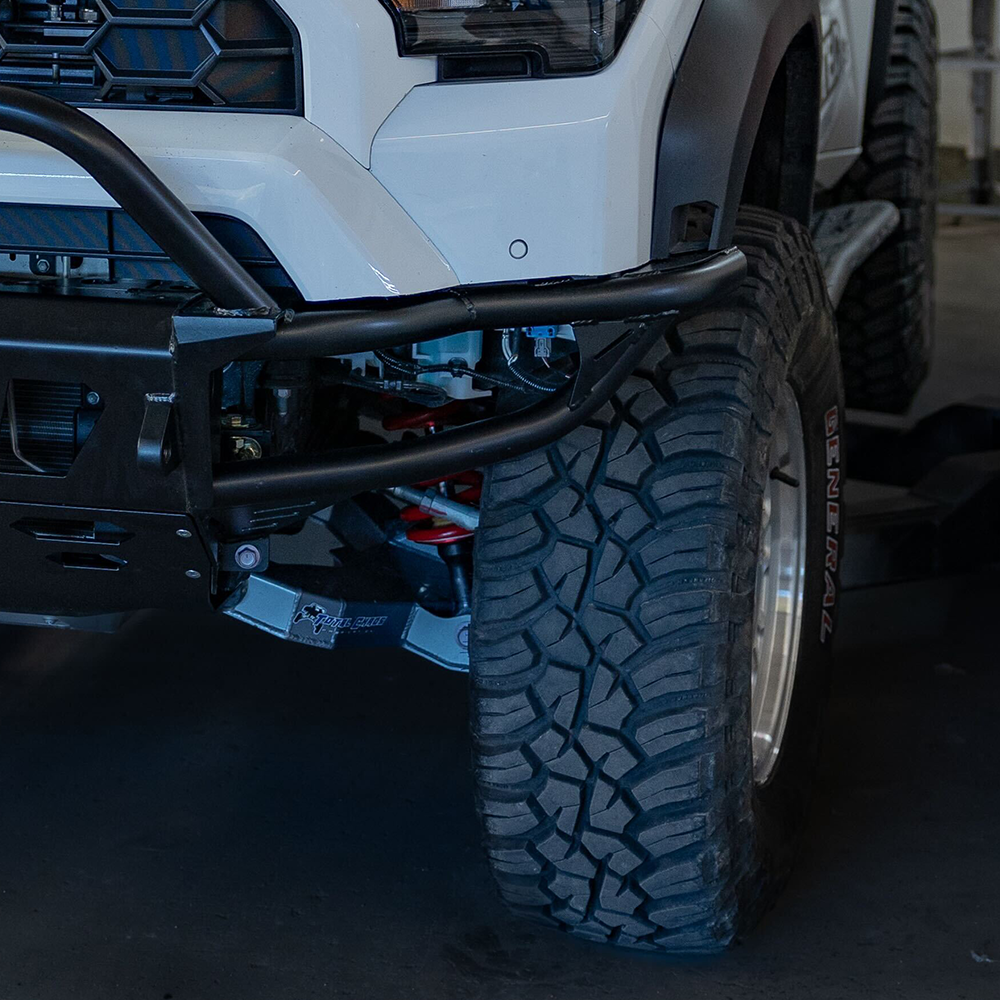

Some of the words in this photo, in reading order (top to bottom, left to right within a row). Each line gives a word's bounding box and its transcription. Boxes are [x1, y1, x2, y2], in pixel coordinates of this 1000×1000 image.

[819, 405, 840, 644] GENERAL
[313, 613, 353, 628] TOTAL
[350, 616, 389, 629] CHAOS
